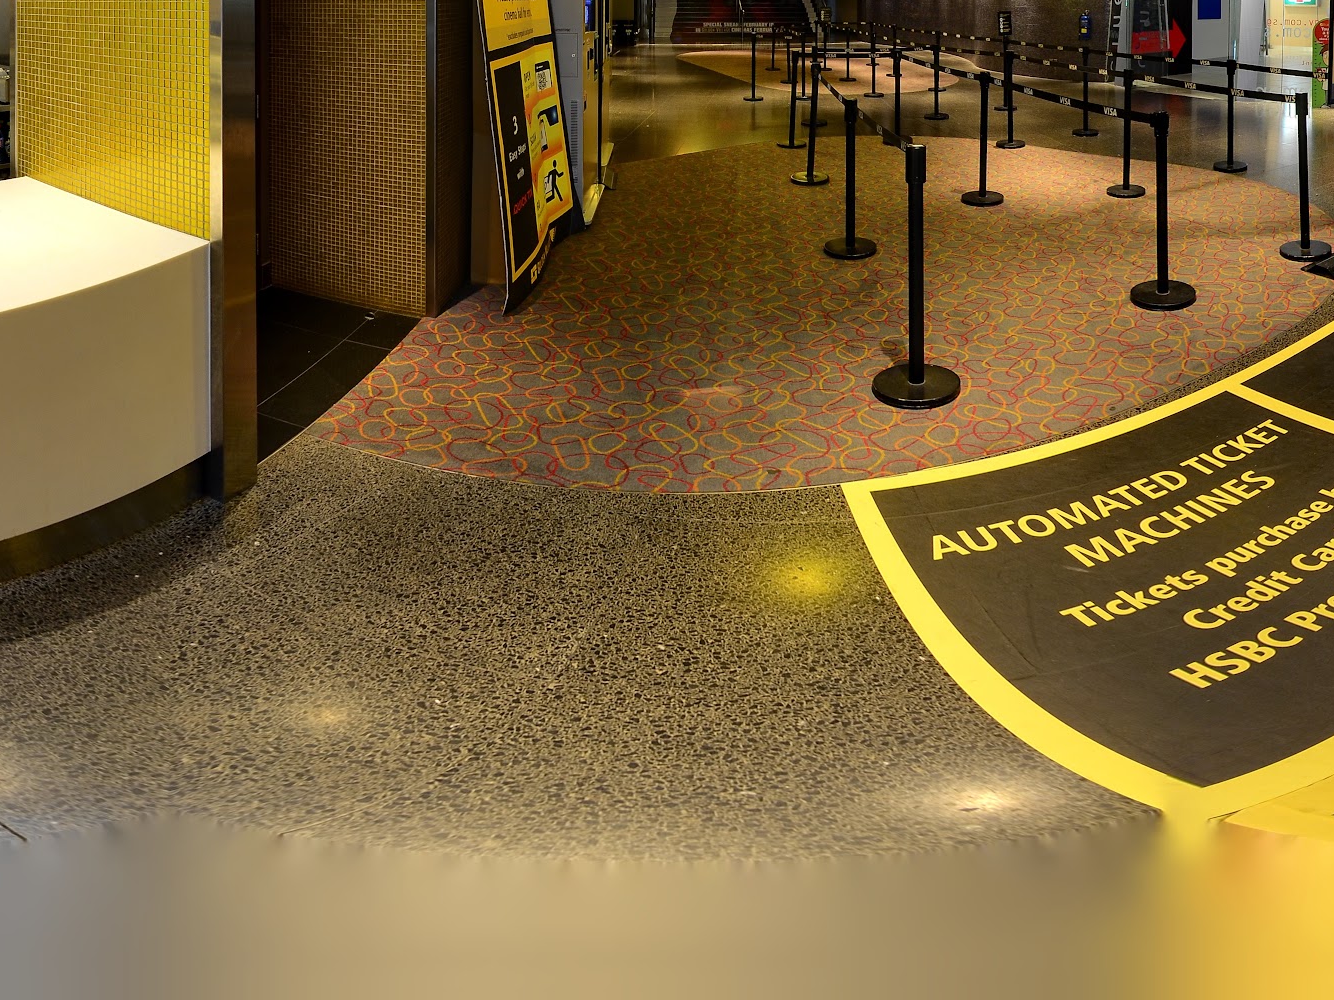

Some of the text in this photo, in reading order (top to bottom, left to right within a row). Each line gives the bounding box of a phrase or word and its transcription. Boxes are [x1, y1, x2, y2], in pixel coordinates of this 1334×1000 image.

[1145, 75, 1155, 83] VISA
[1024, 87, 1033, 96] VISA
[1184, 82, 1196, 90] VISA
[1231, 88, 1244, 97] VISA
[1060, 96, 1071, 106] VISA
[1285, 95, 1296, 103] VIS
[1104, 107, 1117, 117] VISA
[512, 116, 519, 135] 3
[509, 149, 519, 162] Easy
[932, 419, 1289, 560] AUTOMATED TICKET
[1064, 470, 1276, 568] MACHINES
[1059, 568, 1209, 628] Tickets
[1205, 500, 1332, 577] purchase
[1182, 570, 1303, 630] Credit
[1168, 627, 1303, 689] HSBC
